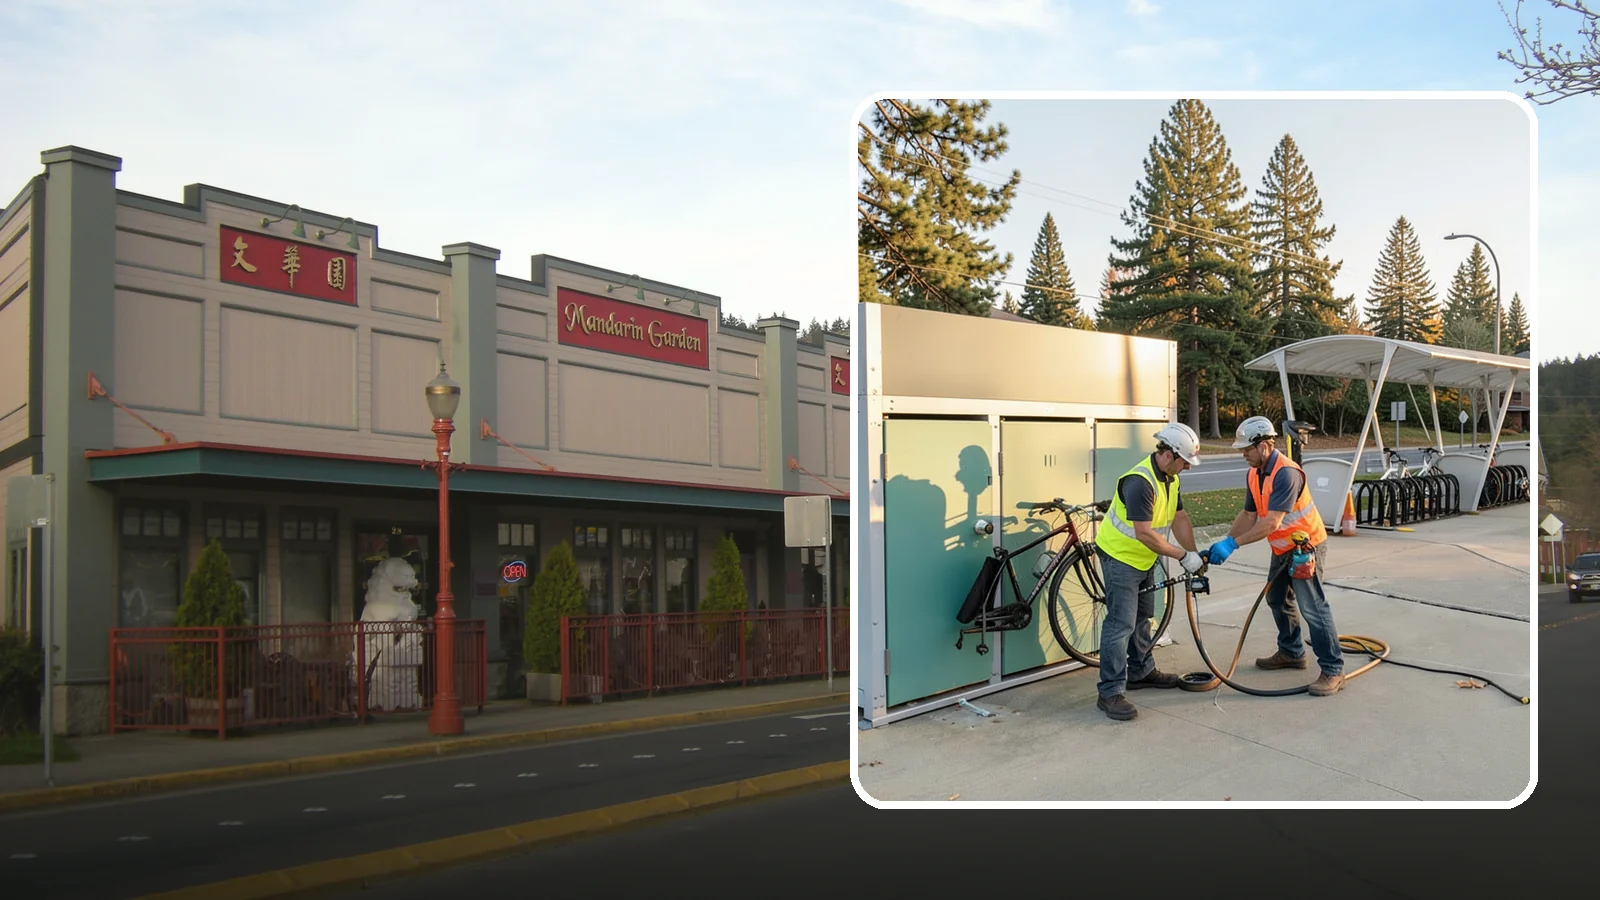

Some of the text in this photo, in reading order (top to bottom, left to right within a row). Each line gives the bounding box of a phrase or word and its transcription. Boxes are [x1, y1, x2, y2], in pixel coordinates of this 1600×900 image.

[231, 235, 346, 291] 文華園
[564, 302, 701, 352] Mandarin Garden
[503, 565, 527, 578] OPEN
